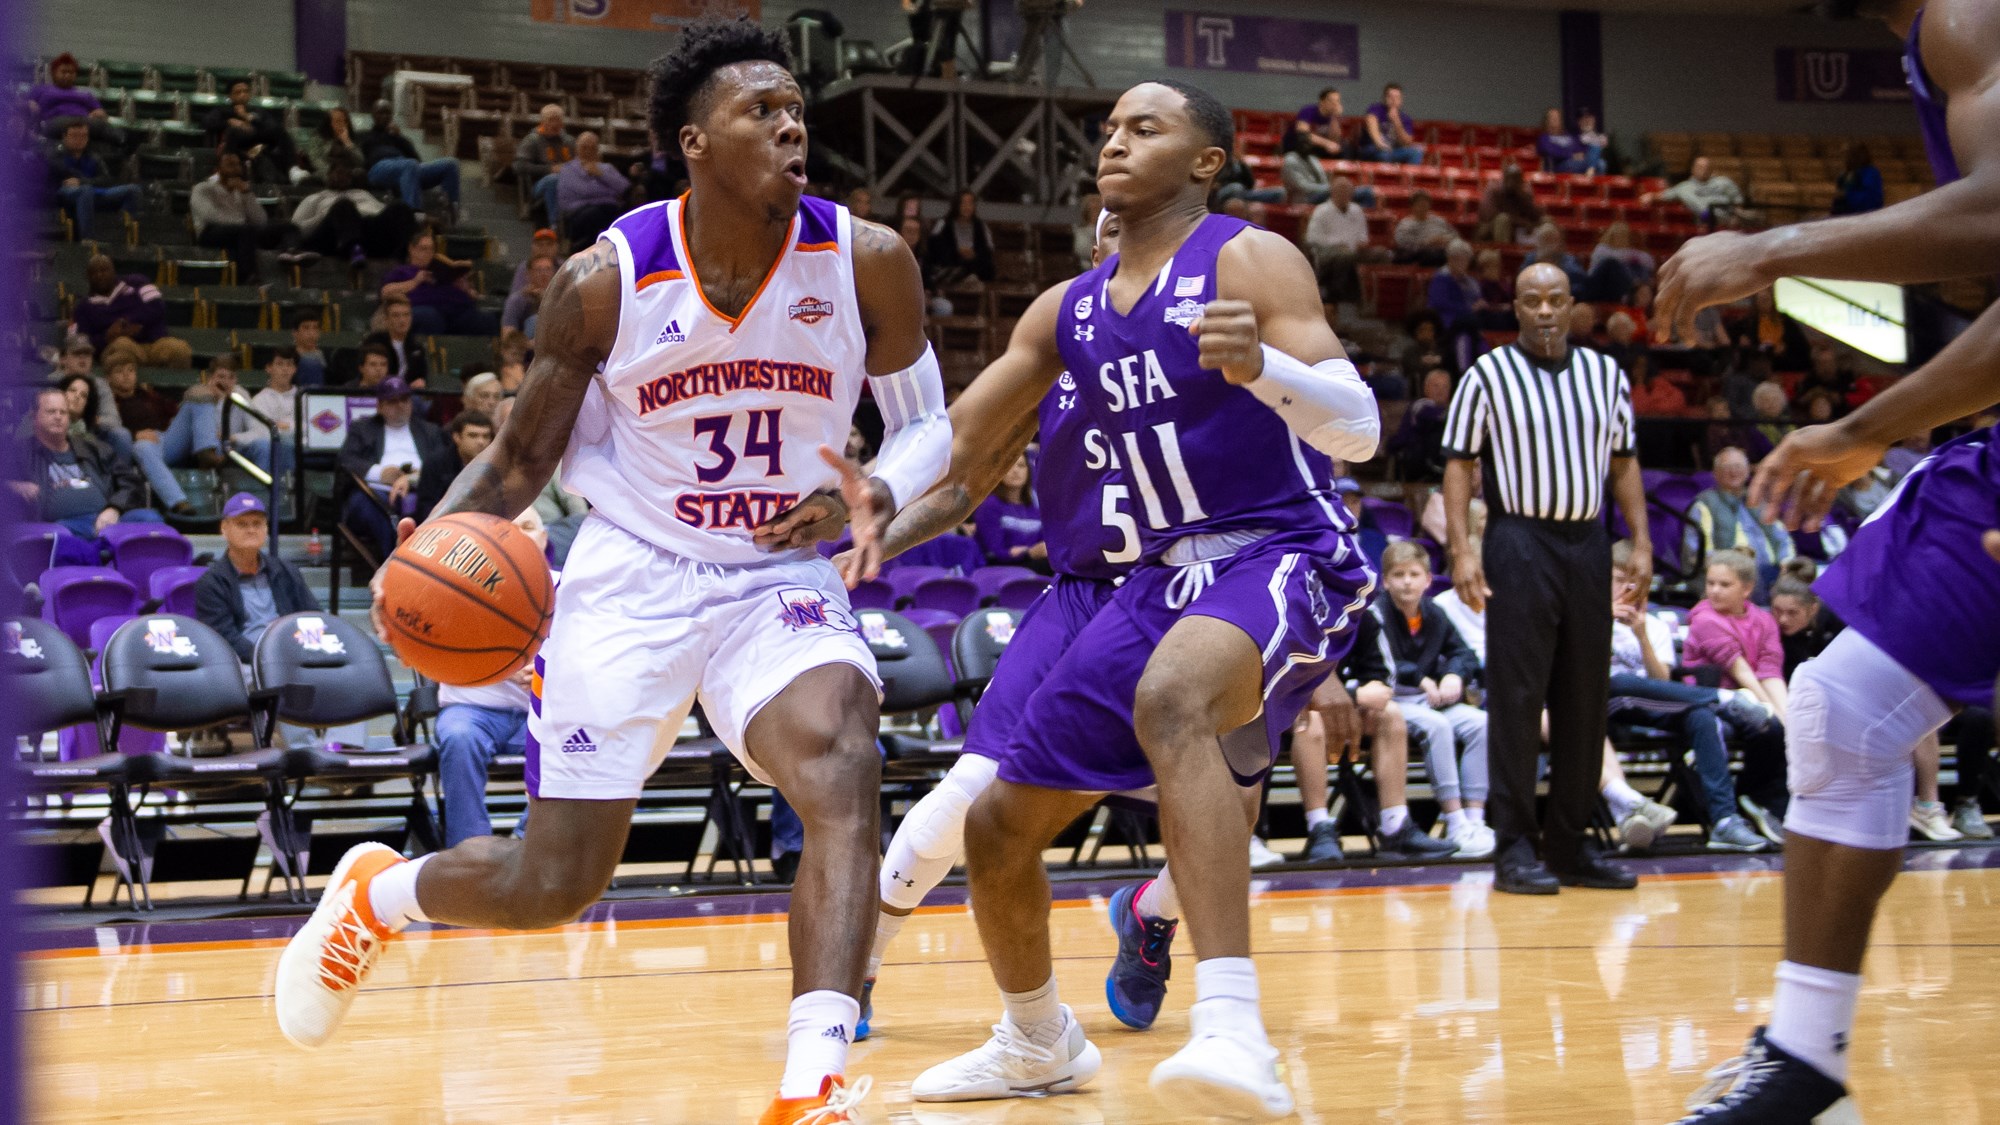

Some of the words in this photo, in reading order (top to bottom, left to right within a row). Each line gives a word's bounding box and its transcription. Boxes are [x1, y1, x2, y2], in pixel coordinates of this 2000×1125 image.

[1197, 17, 1234, 67] T
[1805, 52, 1849, 98] U
[656, 331, 686, 345] adidas
[636, 357, 835, 416] NORTHWESTERN
[1099, 349, 1178, 413] SFA
[693, 407, 785, 484] 34
[1121, 421, 1210, 530] 11
[1102, 484, 1143, 564] 5
[438, 534, 506, 598] ROCK
[790, 603, 826, 626] N
[561, 744, 597, 753] adidas
